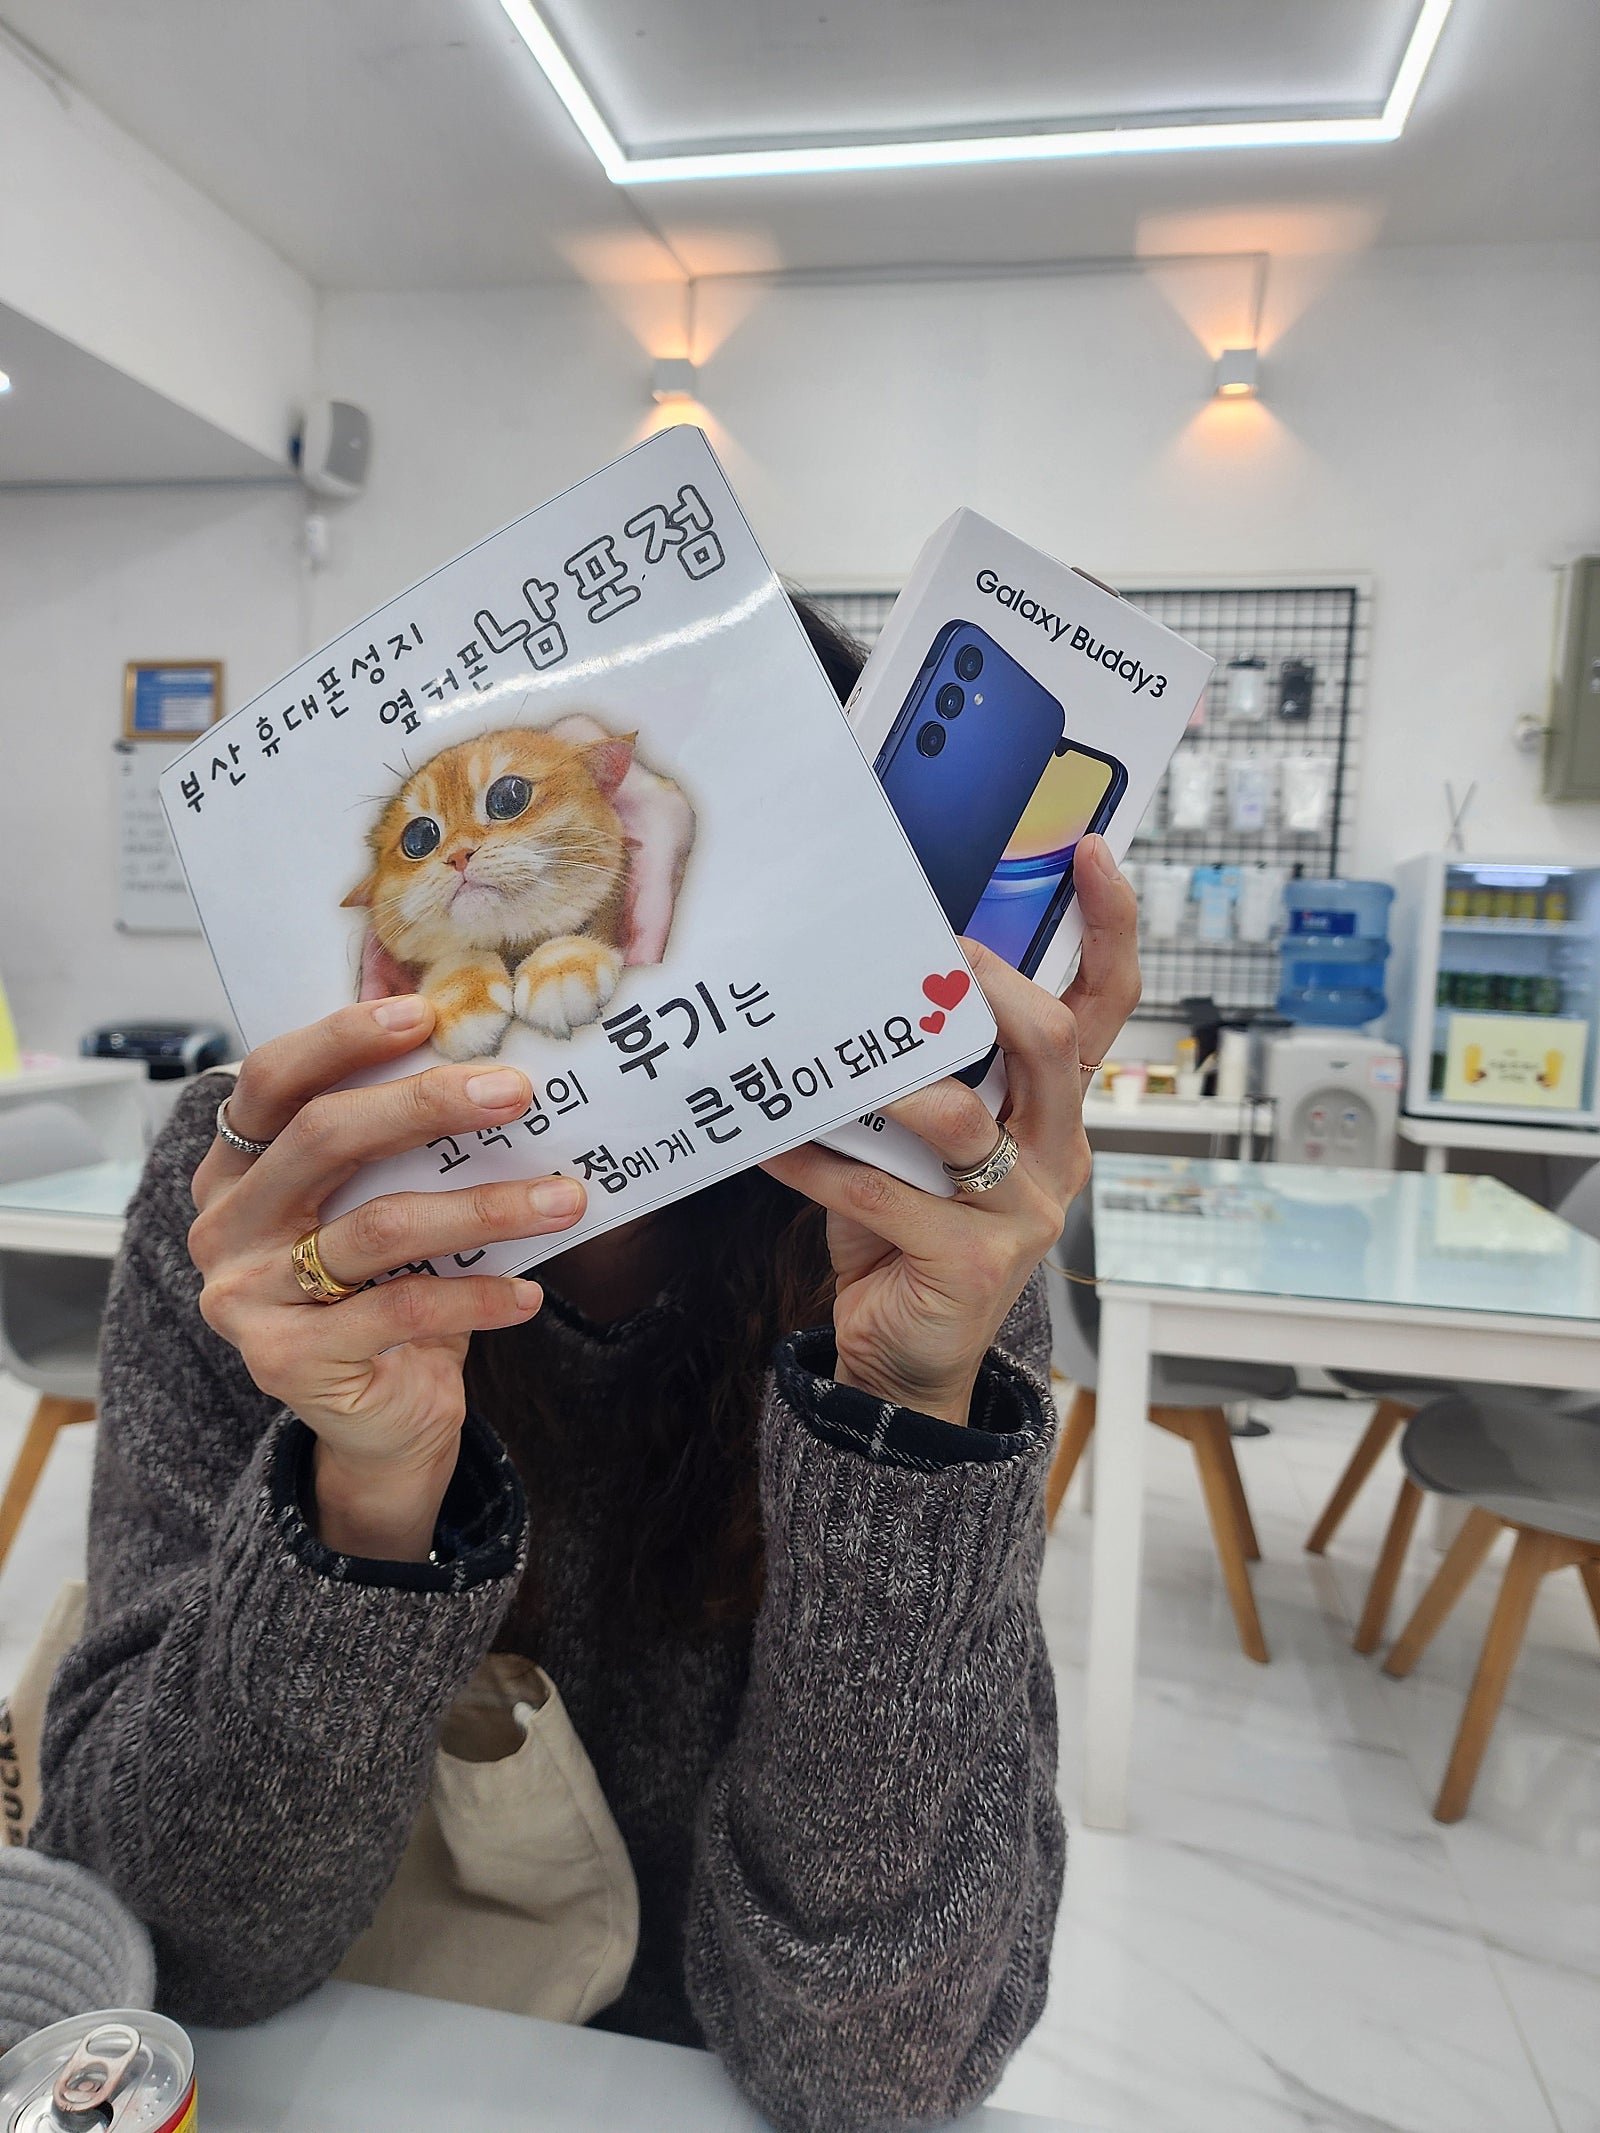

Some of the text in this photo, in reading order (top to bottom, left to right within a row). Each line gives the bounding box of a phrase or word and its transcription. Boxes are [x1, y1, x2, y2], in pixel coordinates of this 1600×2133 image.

[474, 484, 726, 672] 남포점
[976, 569, 1168, 699] Galaxy Buddy3
[181, 743, 246, 813] 부산
[601, 981, 777, 1081] 후기는
[835, 1015, 925, 1081] 돼요
